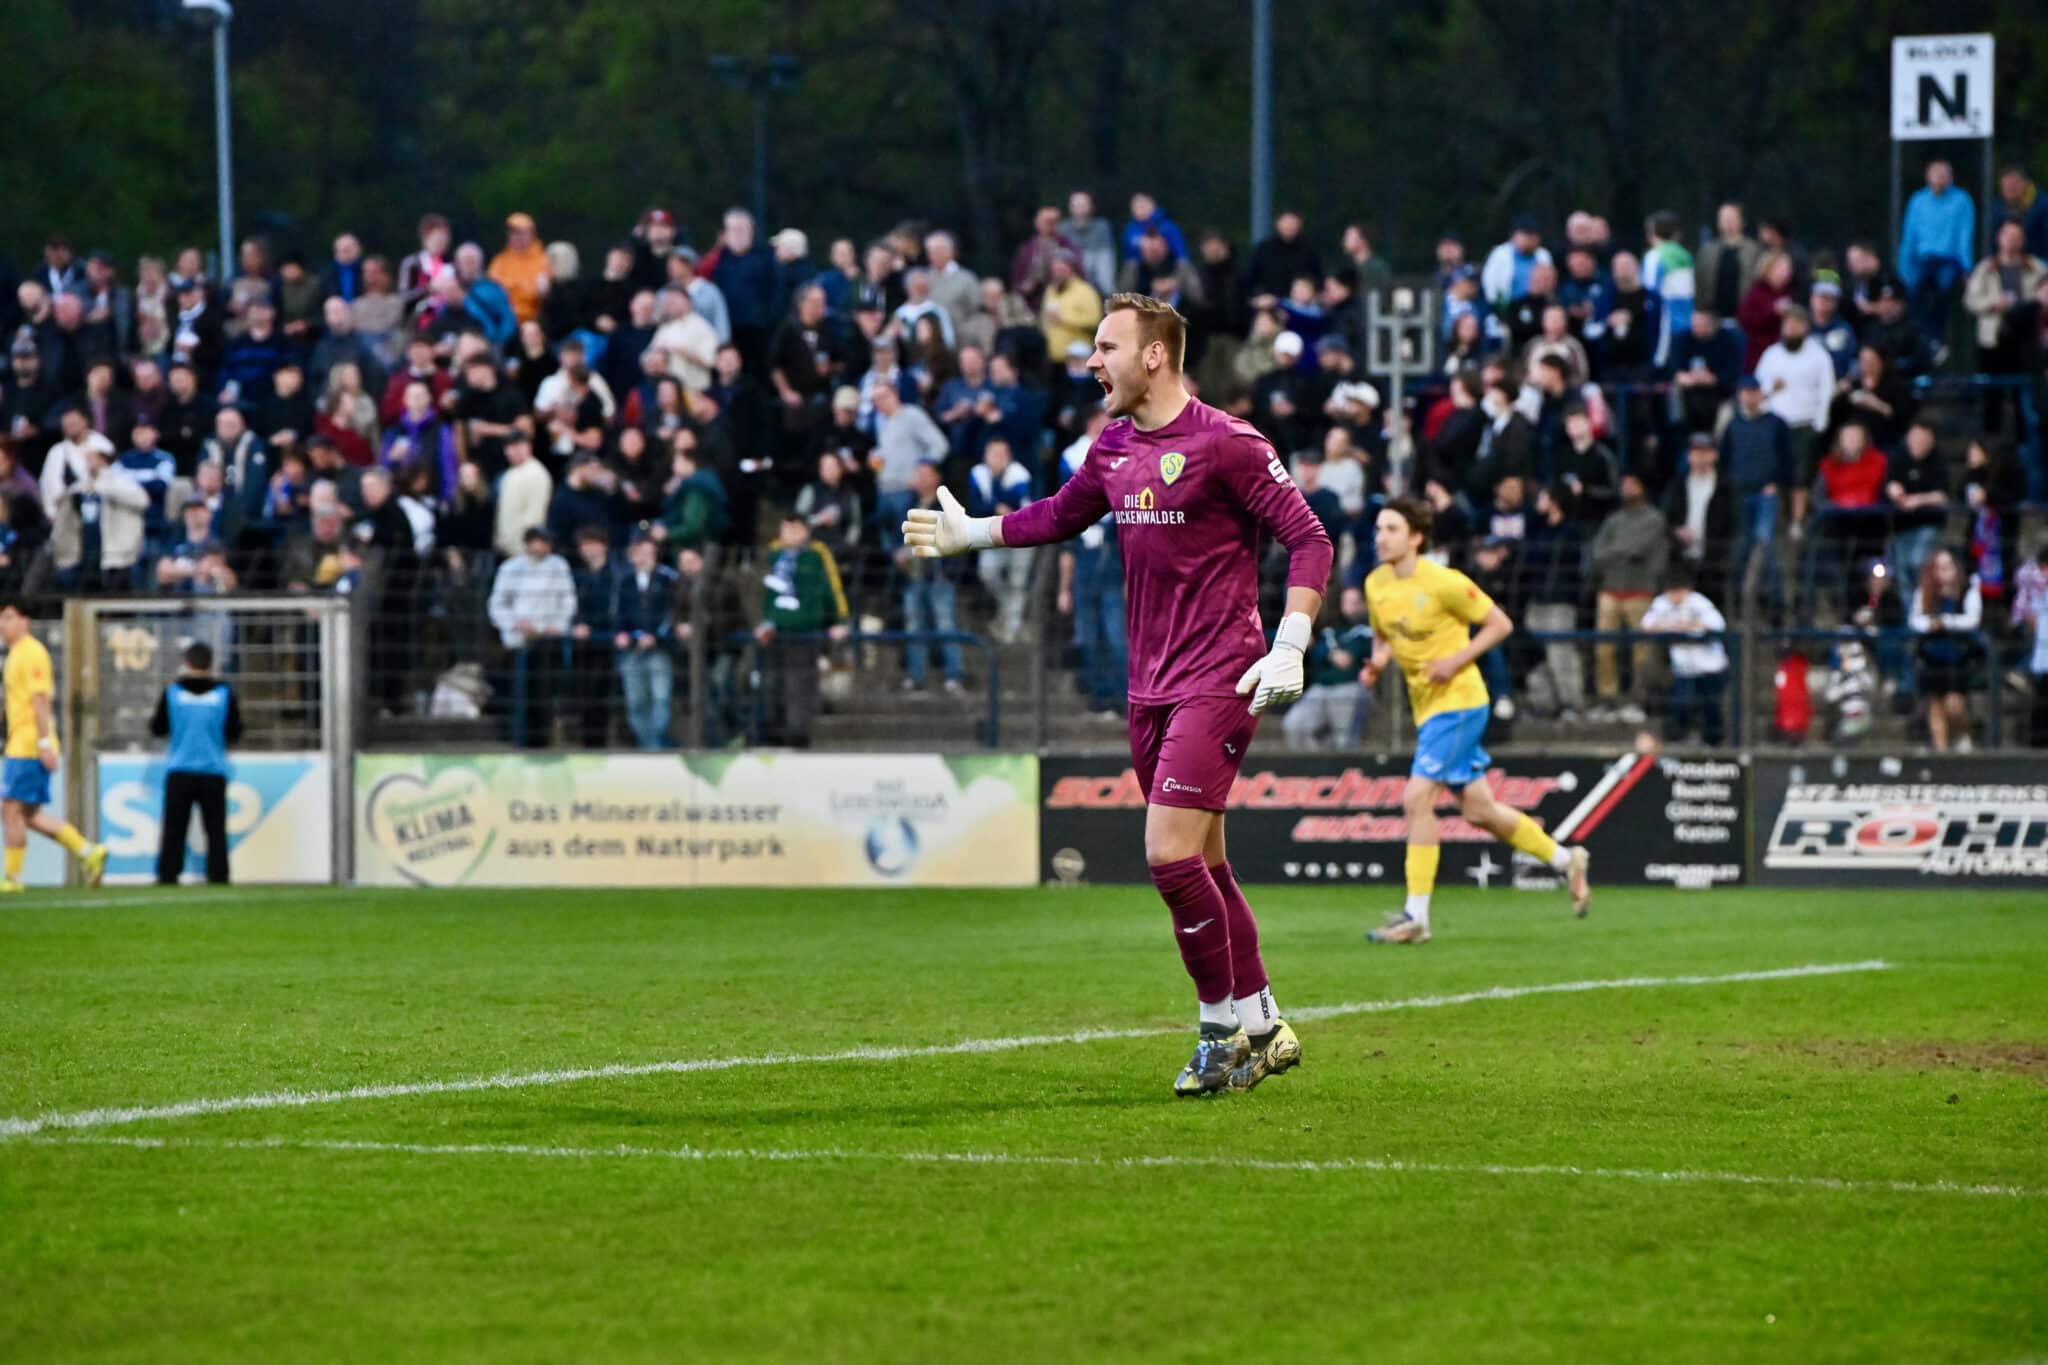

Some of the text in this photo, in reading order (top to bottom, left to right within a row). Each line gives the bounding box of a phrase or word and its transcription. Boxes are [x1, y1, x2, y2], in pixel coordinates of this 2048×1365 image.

[1917, 73, 1968, 127] N
[1124, 494, 1140, 508] DIE
[1662, 760, 1740, 780] Potsdam
[508, 799, 781, 822] Das Mineralwasser
[507, 836, 785, 863] aus dem Naturpark
